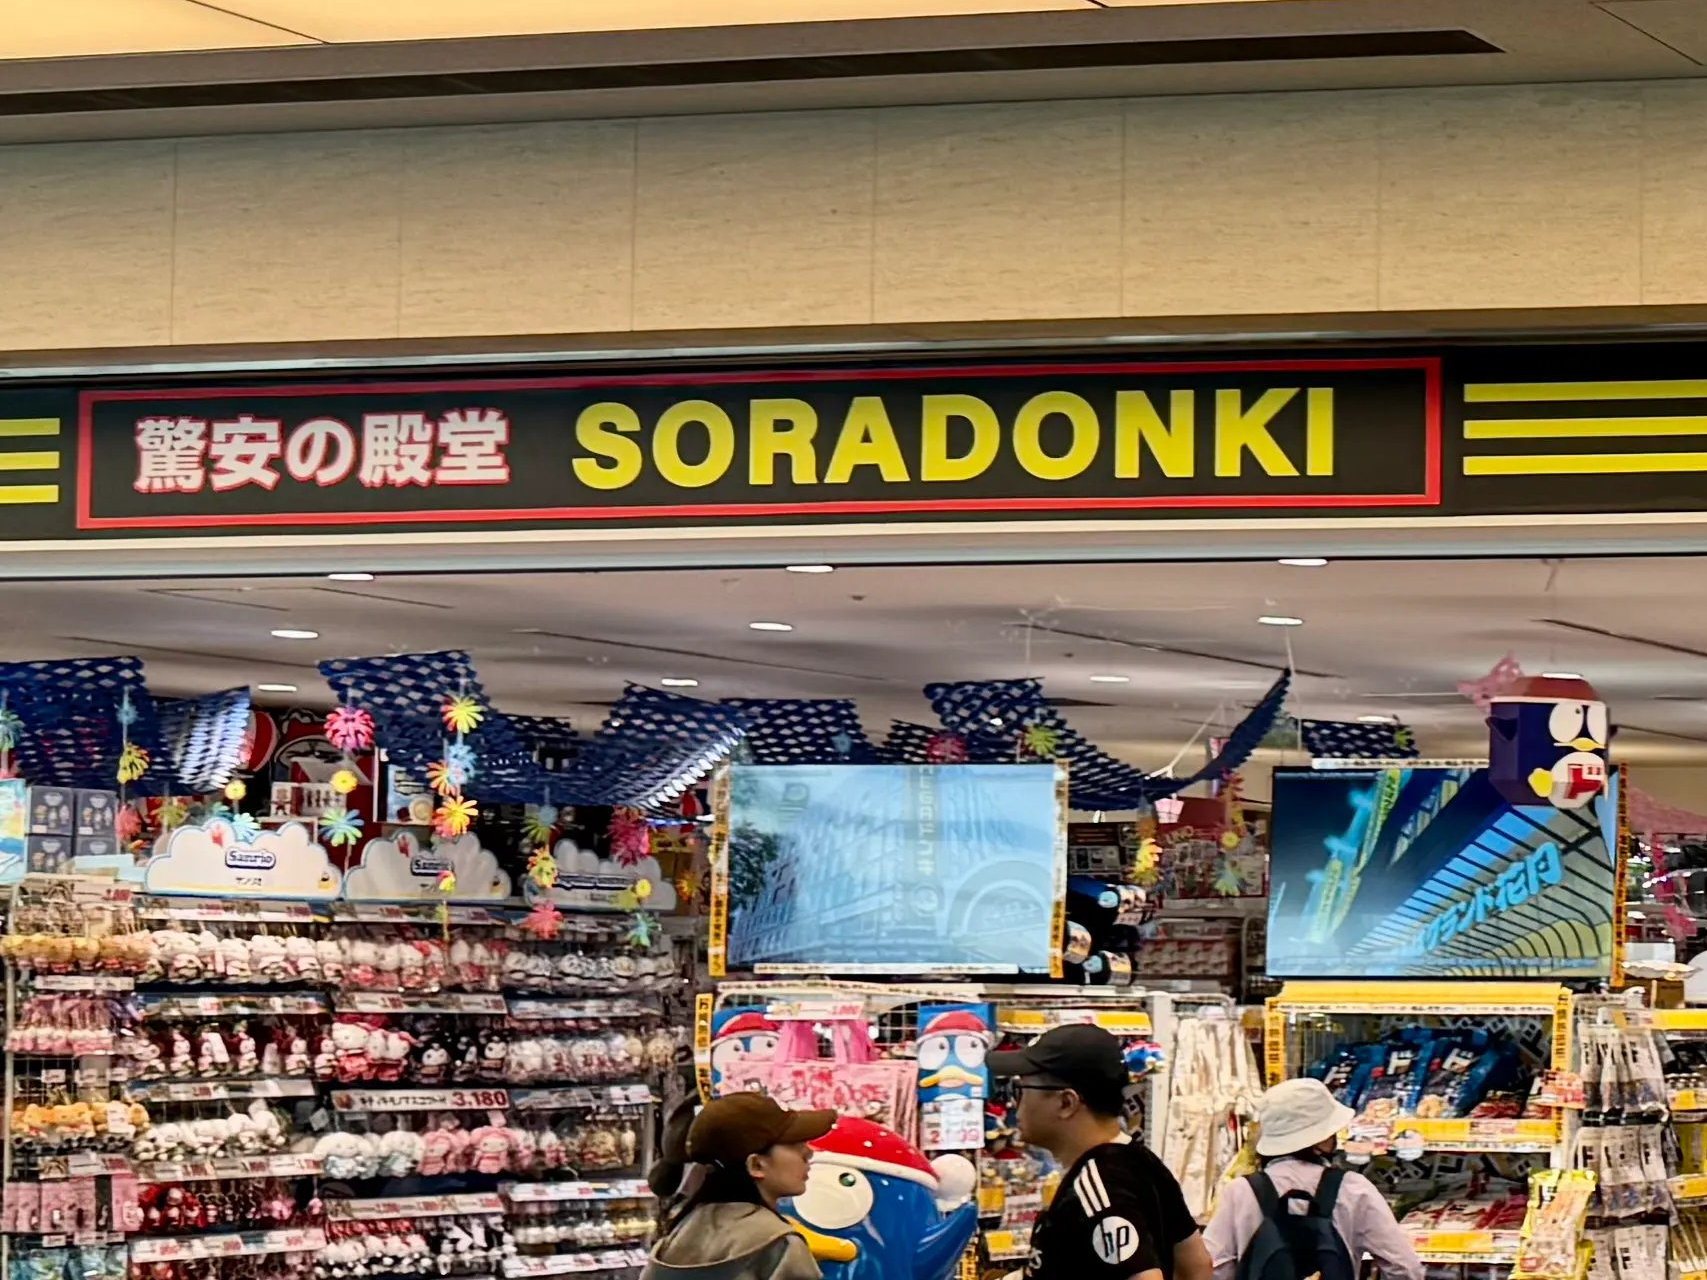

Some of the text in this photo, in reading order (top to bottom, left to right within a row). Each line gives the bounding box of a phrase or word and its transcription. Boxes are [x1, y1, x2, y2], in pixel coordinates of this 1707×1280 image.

[134, 409, 510, 493] 驚安の殿堂
[572, 387, 1334, 490] SORADONKI
